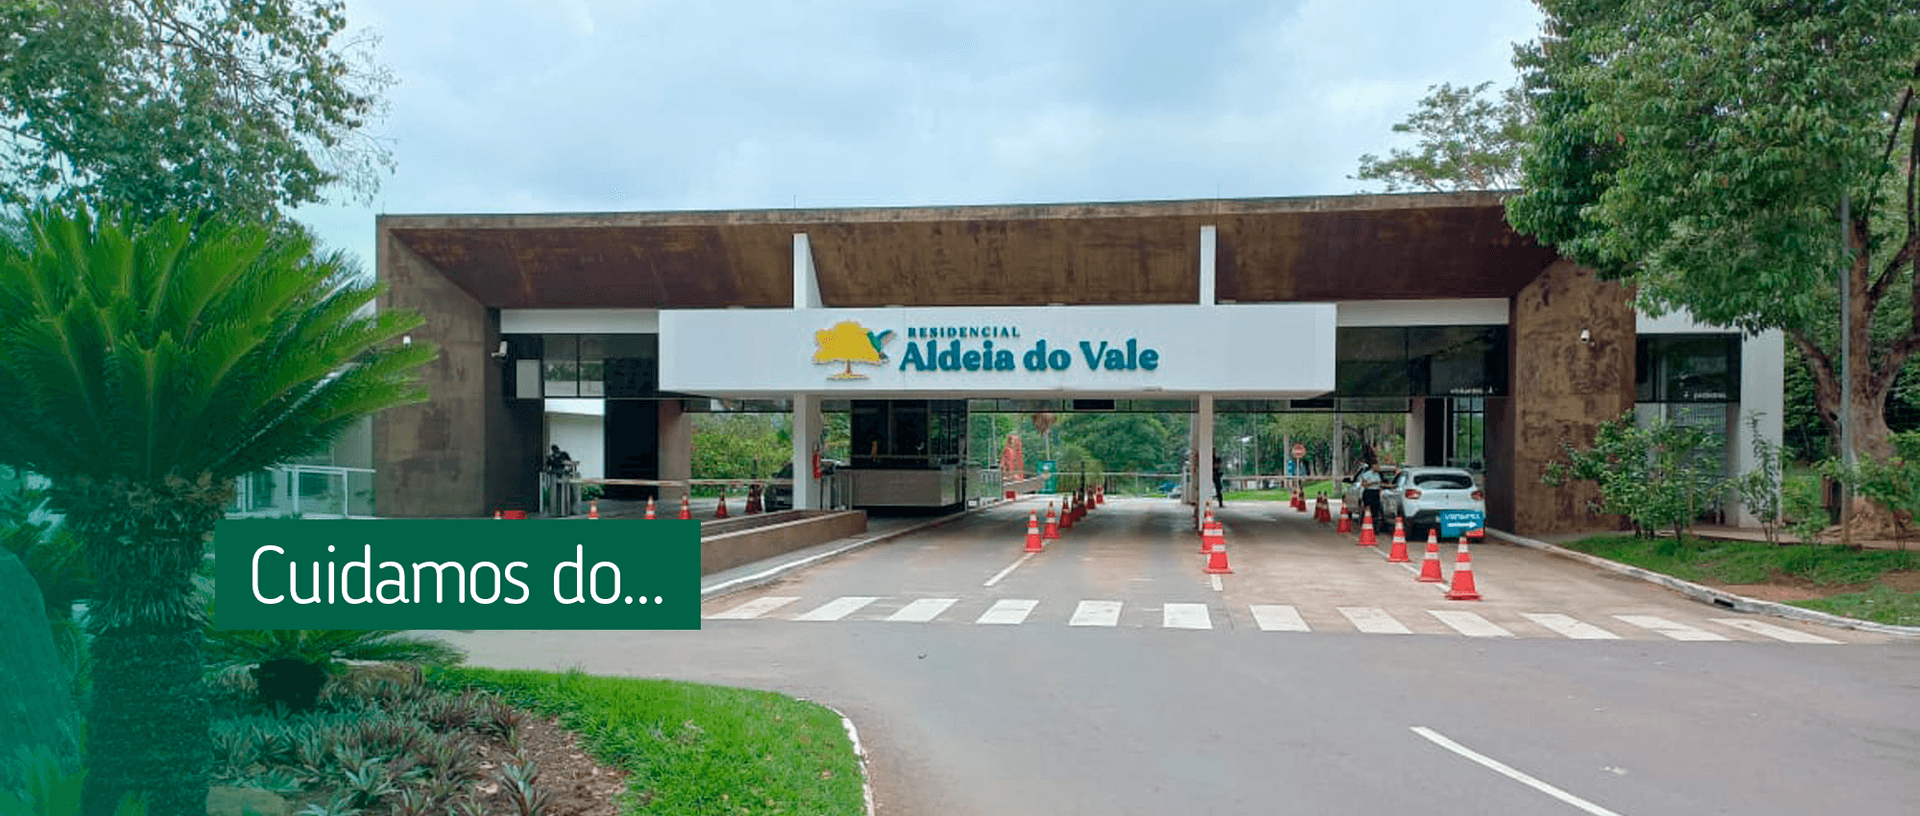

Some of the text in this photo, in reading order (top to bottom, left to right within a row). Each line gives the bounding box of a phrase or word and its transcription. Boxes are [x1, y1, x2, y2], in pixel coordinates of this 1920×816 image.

[907, 326, 1020, 338] RESIDENCIAL
[899, 338, 1159, 371] Aldeia do Vale
